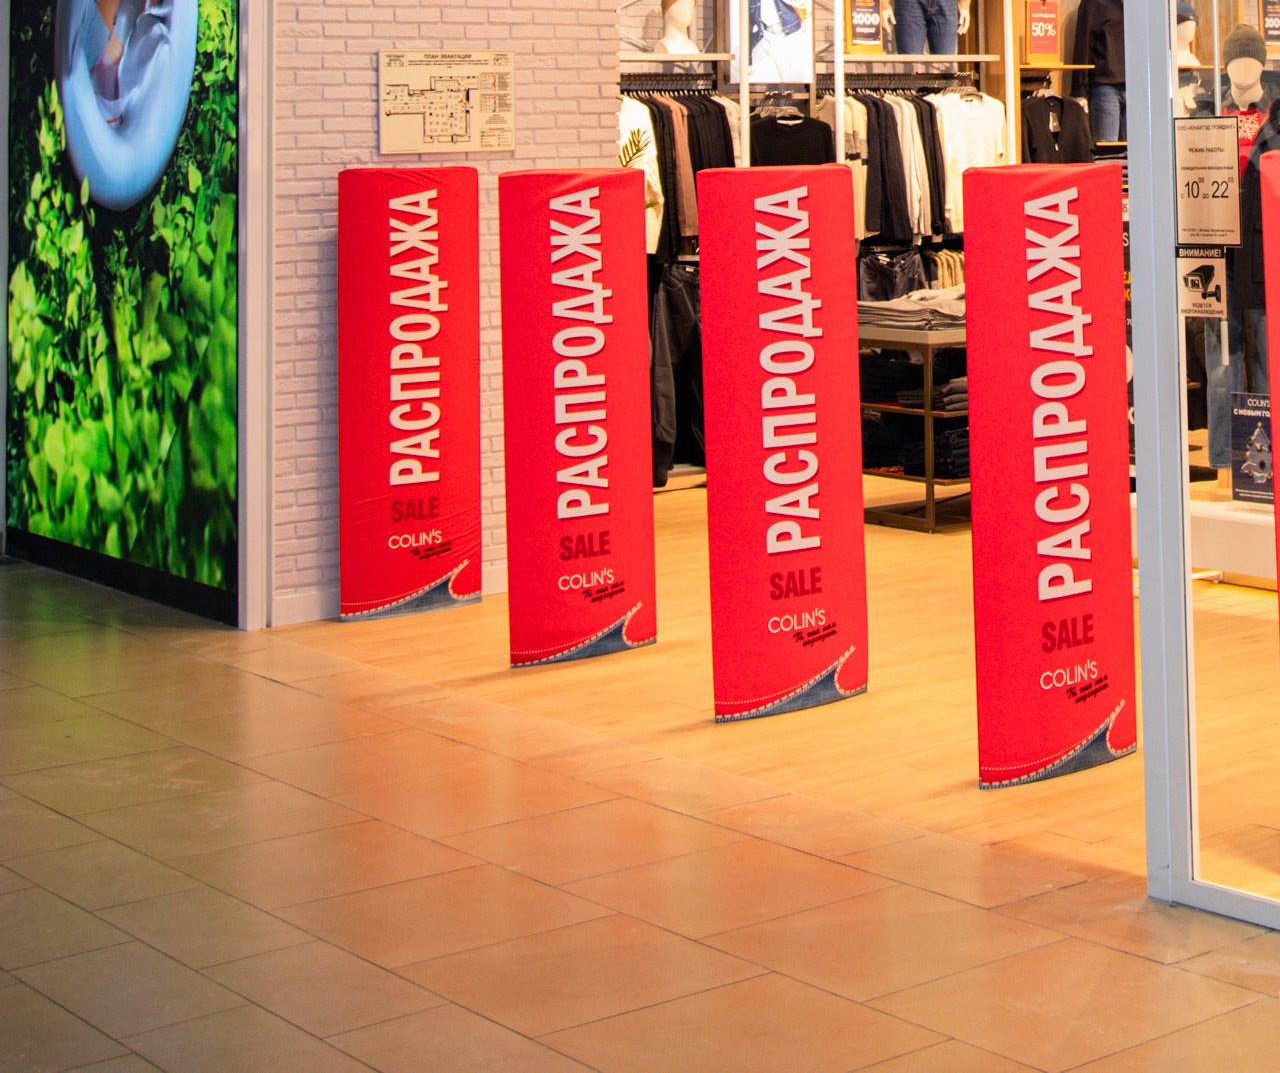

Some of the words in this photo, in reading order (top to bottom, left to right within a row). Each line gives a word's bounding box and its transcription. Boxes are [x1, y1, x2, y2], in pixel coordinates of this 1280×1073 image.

[852, 12, 880, 26] 2000
[1031, 22, 1056, 37] 50%
[1178, 249, 1221, 257] ВНИМАНИЕ!
[389, 188, 448, 486] РАСПРОДАЖА
[550, 186, 612, 518] РАСПРОДАЖА
[755, 185, 822, 554] РАСПРОДАЖА
[1024, 186, 1093, 601] РАСПРОДАЖА
[1247, 398, 1270, 408] COLIN'S
[1238, 409, 1262, 417] НОВЫМ
[391, 496, 439, 523] SALE
[388, 528, 442, 549] COLIN'S
[560, 530, 611, 562] SALE
[558, 567, 614, 591] COLIN'S
[770, 566, 823, 601] SALE
[767, 607, 826, 633] COLIN'S
[1041, 613, 1094, 653] SALE
[1040, 659, 1098, 690] COLIN'S
